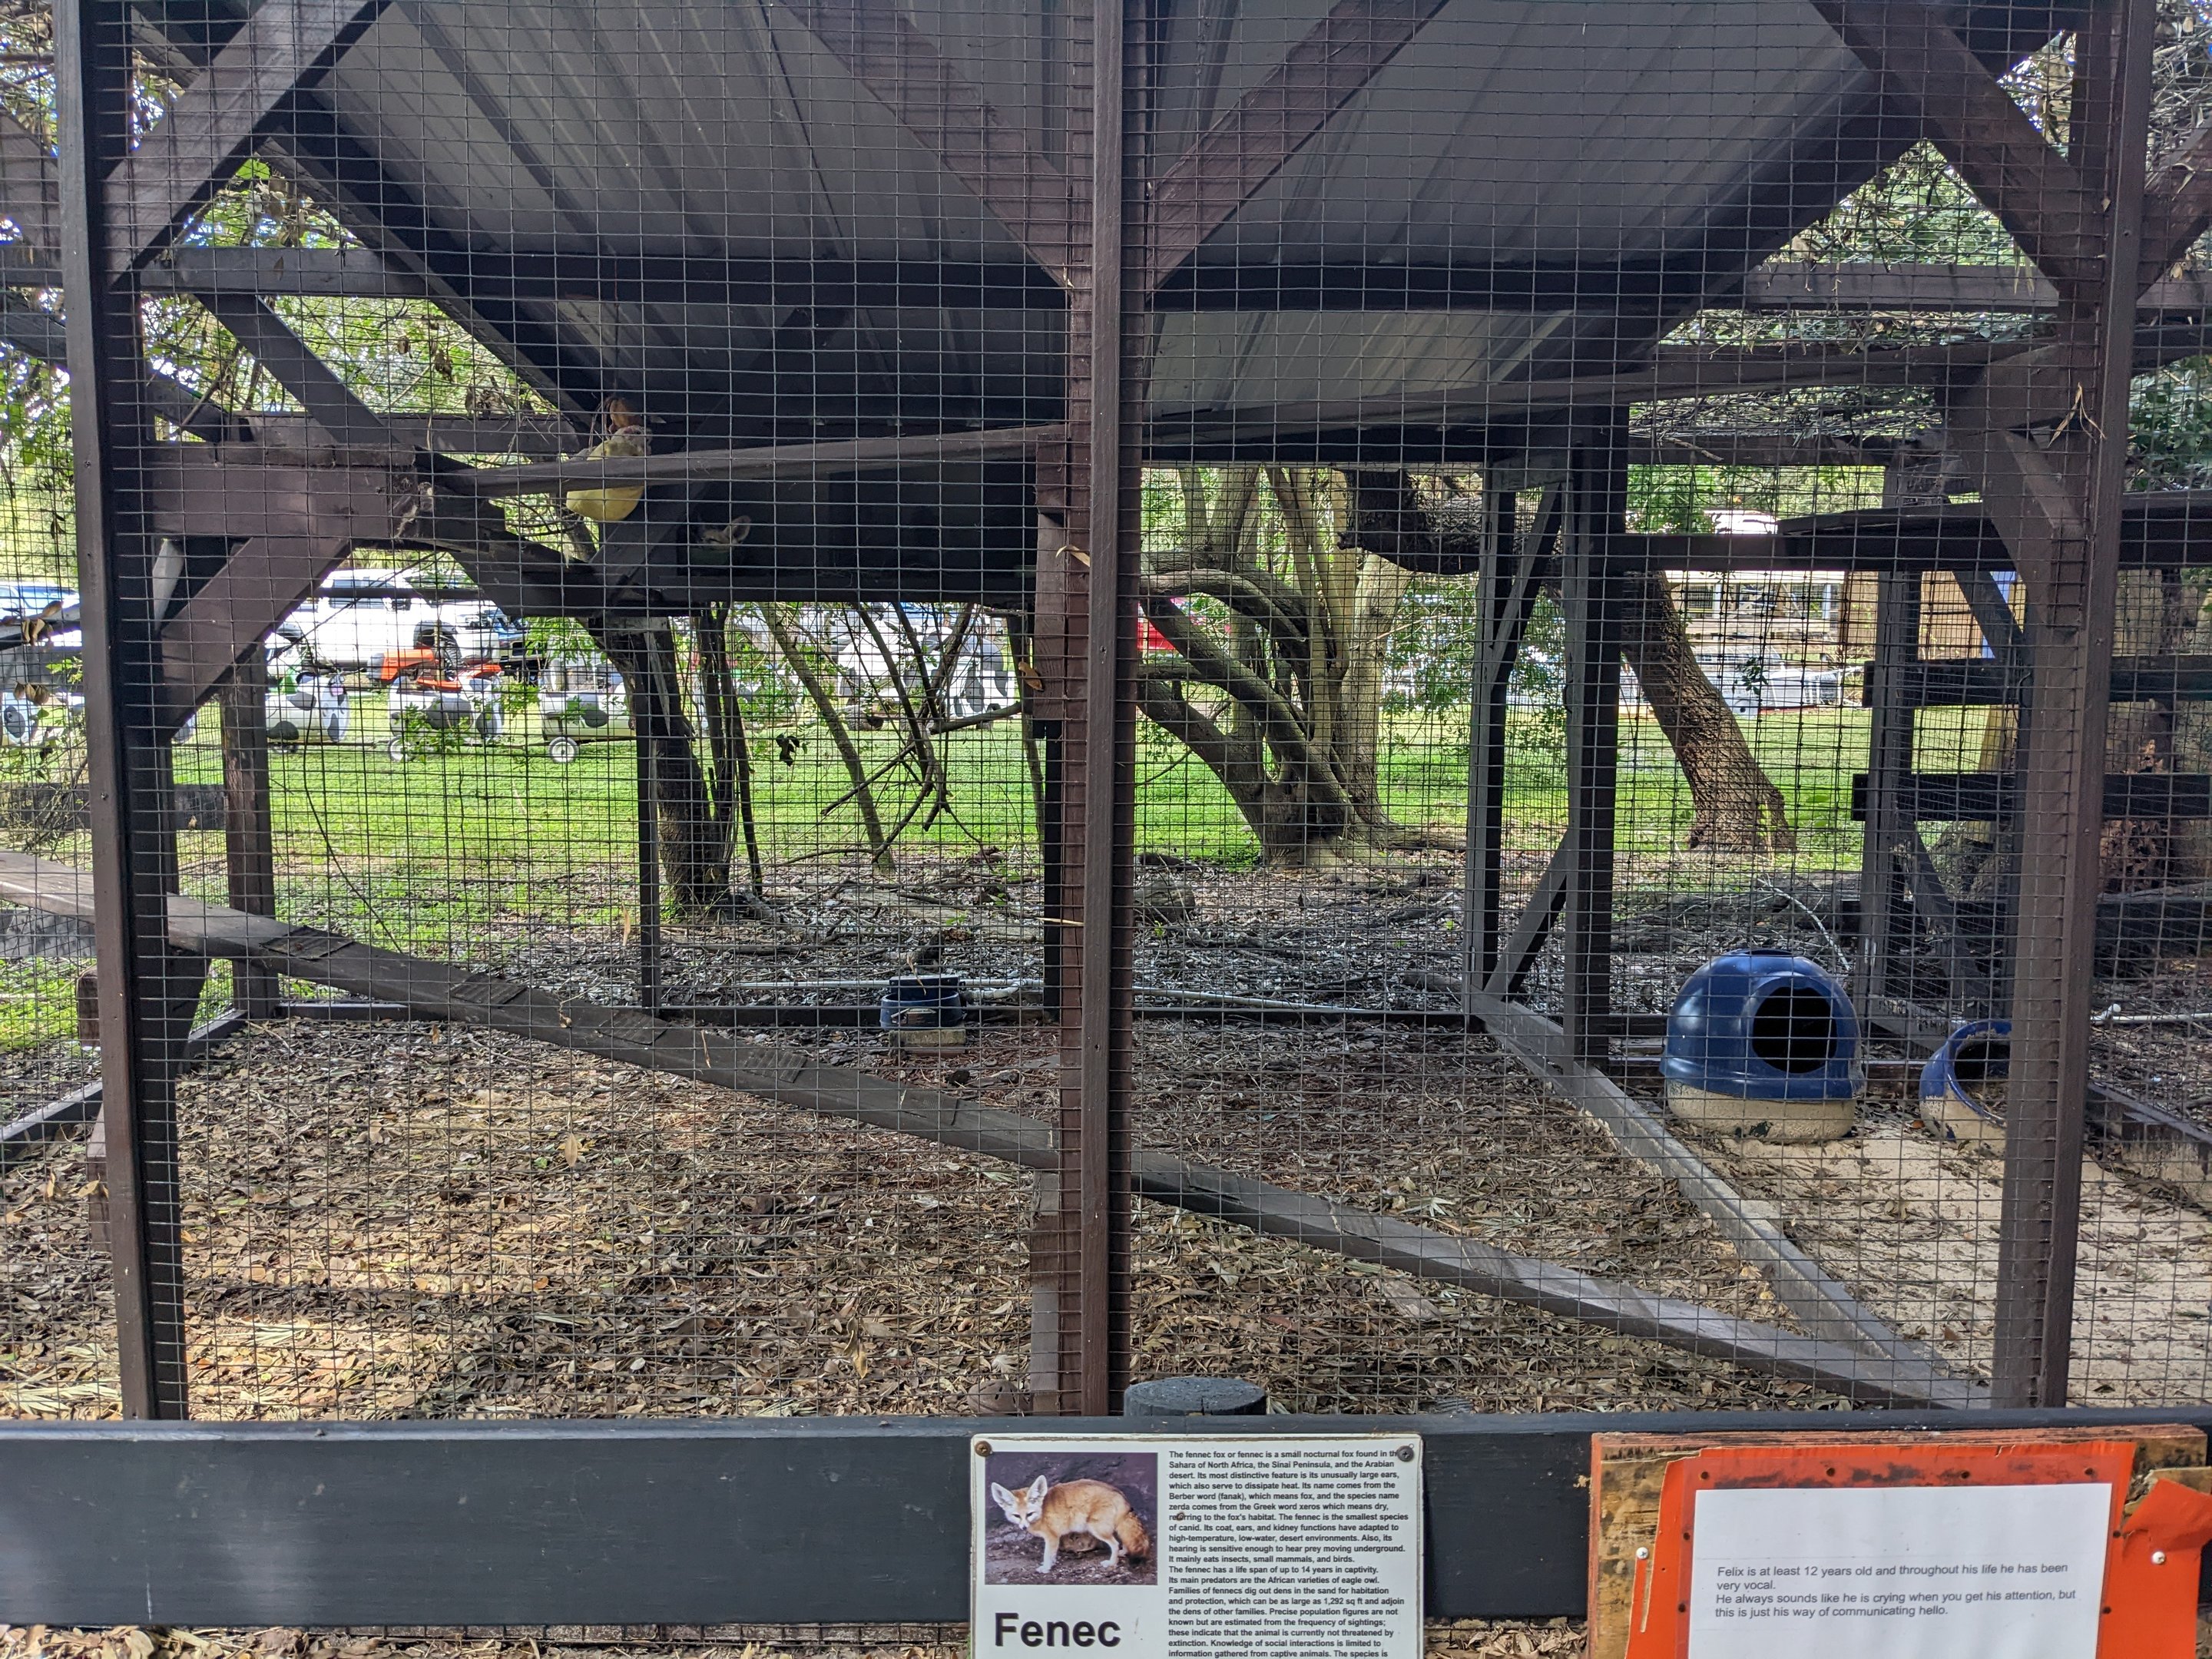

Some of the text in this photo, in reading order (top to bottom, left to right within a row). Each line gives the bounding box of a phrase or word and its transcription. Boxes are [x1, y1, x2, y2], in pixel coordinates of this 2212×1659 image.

[1320, 1472, 1358, 1480] unusually
[1359, 1471, 1379, 1479] large
[1218, 1492, 1246, 1501] (fanak),
[1169, 1514, 1201, 1522] rerring
[1379, 1513, 1409, 1522] species
[1169, 1535, 1237, 1543] high-temperature,
[1169, 1545, 1197, 1554] hearing
[1323, 1545, 1352, 1553] moving
[1354, 1545, 1406, 1553] underground.
[1176, 1555, 1201, 1564] mainly
[1718, 1563, 2068, 1578] Felix is at least 12 years old and throughout his life he has been
[1201, 1577, 1237, 1585] predators
[1341, 1576, 1362, 1584] eagle
[1717, 1580, 1776, 1592] very vocal.
[1716, 1590, 2075, 1605] He always sounds like he is crying when you get his attention, but
[1300, 1608, 1340, 1616] population
[1343, 1608, 1369, 1616] figures
[1715, 1605, 1948, 1619] this is just his way of communicating hello.
[1298, 1618, 1336, 1627] frequency
[1348, 1618, 1386, 1627] sightings;
[995, 1613, 1121, 1647] Fenec
[1210, 1640, 1253, 1648] Knowledge
[1214, 1650, 1248, 1659] gathered
[1270, 1650, 1297, 1658] captive
[1349, 1650, 1379, 1658] species
